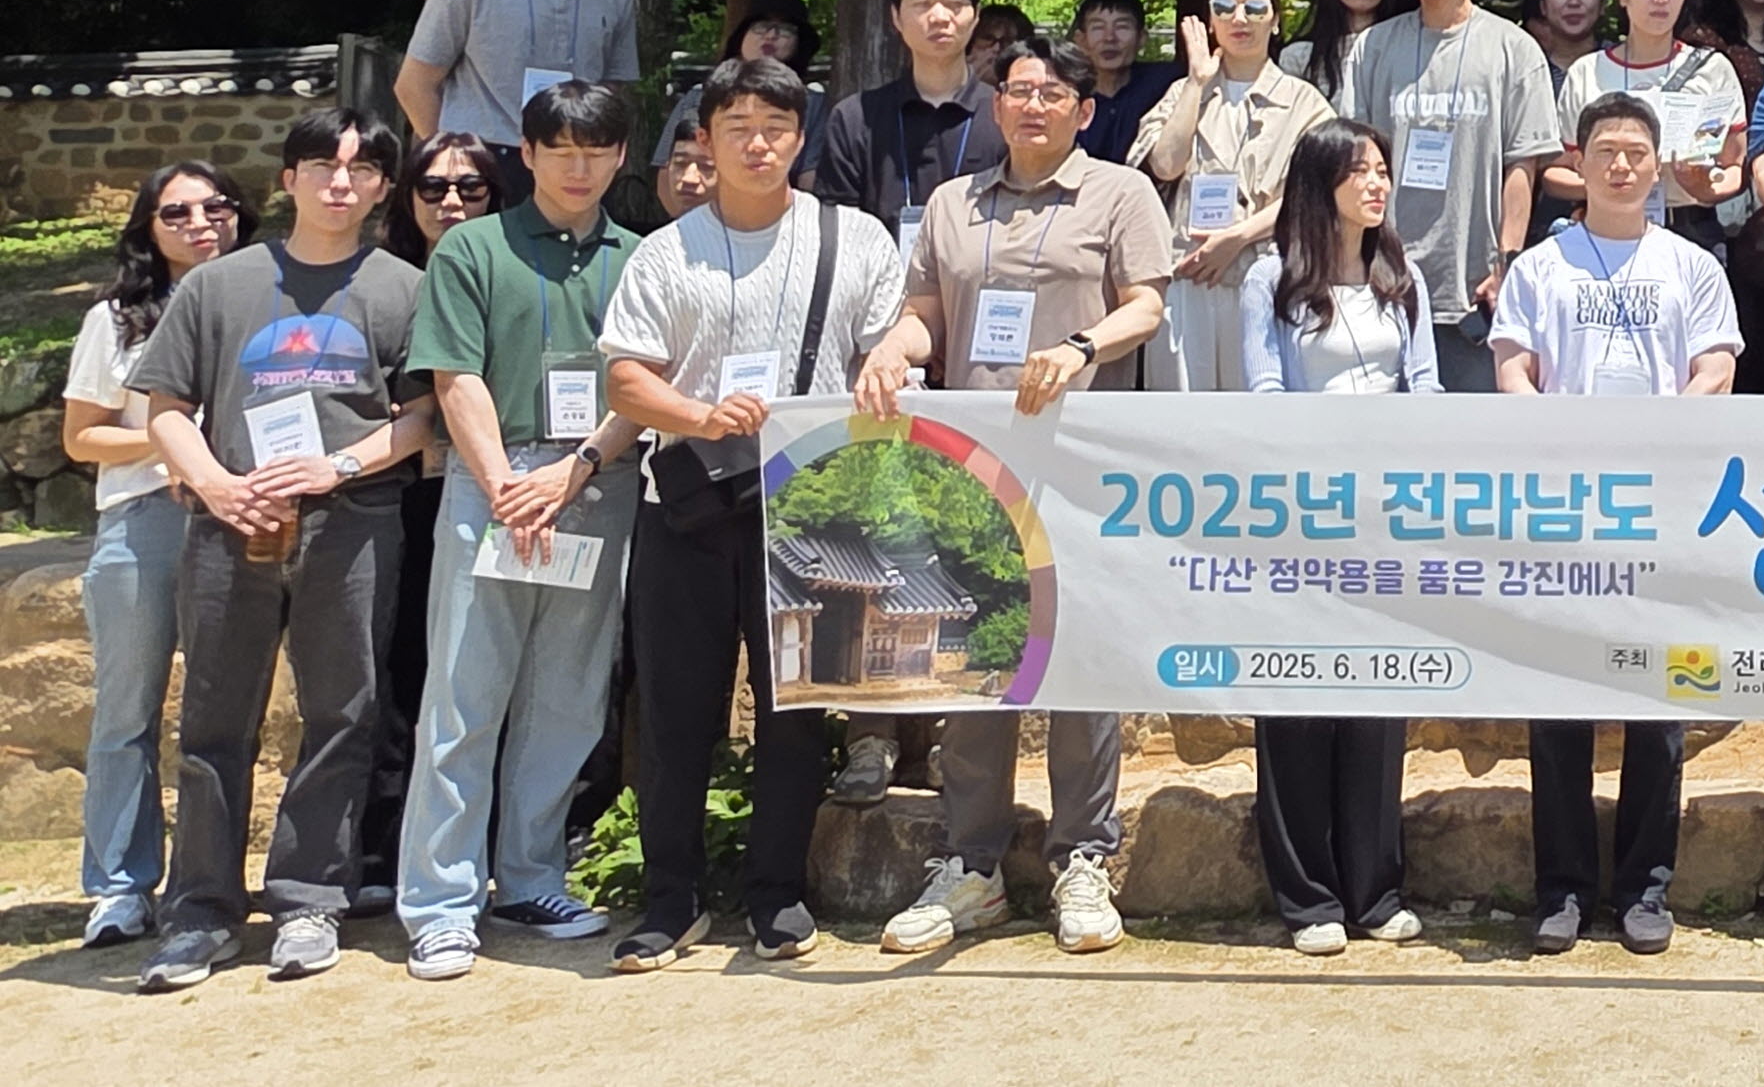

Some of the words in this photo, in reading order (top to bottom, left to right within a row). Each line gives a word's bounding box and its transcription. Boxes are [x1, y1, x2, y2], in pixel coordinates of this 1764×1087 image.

[1100, 471, 1357, 541] 2025년
[1381, 472, 1658, 543] 전라남도
[1268, 557, 1405, 595] 정약용을
[1416, 560, 1486, 597] 품은
[1497, 560, 1656, 598] 강진에서”
[1174, 650, 1225, 682] 일시
[1249, 652, 1324, 680] 2025.
[1333, 653, 1358, 681] 6.
[1368, 651, 1452, 684] 18.(수)
[1611, 649, 1647, 669] 주최
